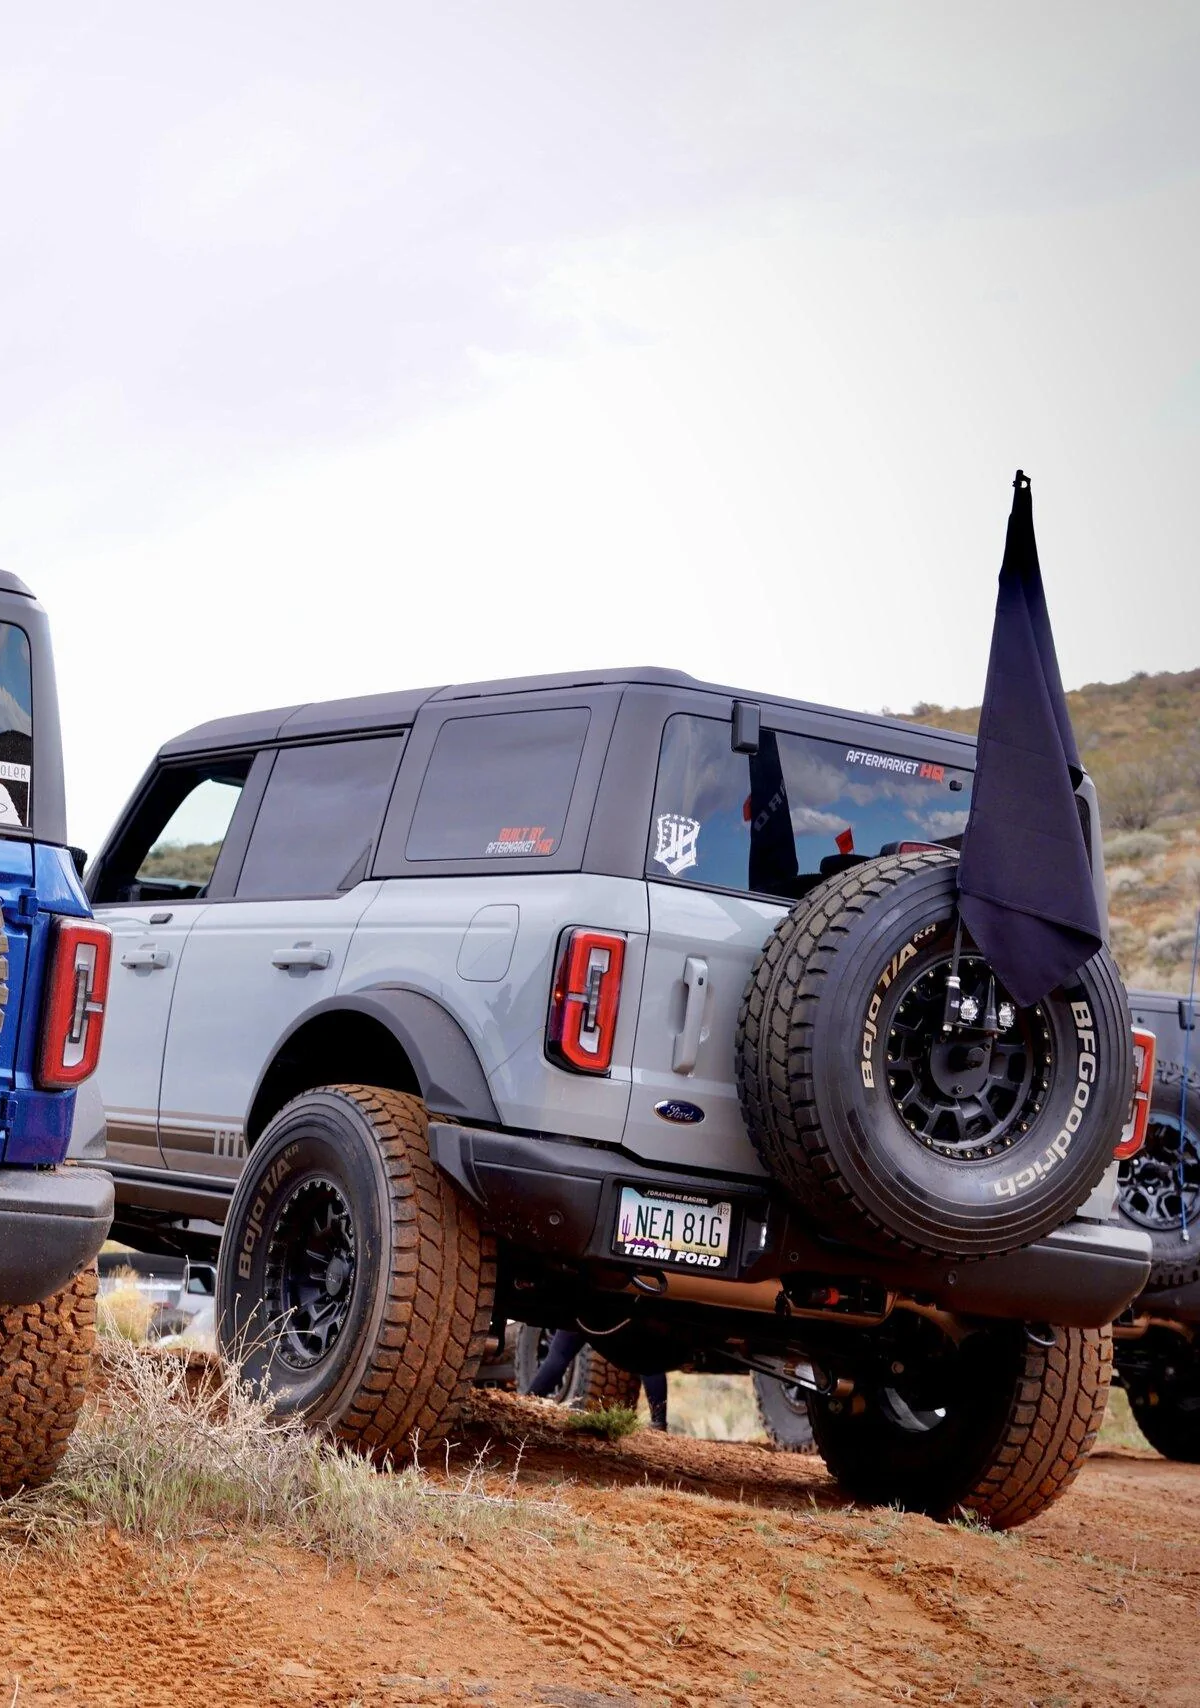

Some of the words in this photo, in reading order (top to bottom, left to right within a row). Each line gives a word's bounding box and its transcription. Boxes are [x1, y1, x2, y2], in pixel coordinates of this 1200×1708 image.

[846, 750, 918, 775] AFTERMARKET
[920, 762, 945, 784] HQ
[485, 840, 536, 854] AFTERMARKET
[860, 993, 882, 1089] Baja
[666, 1104, 695, 1120] Ford
[993, 1001, 1096, 1197] BFGoodrich
[238, 1196, 266, 1280] Baja
[635, 1204, 674, 1242] NEA
[682, 1212, 722, 1248] 81G
[624, 1243, 672, 1261] TEAM
[674, 1251, 721, 1267] FORD
